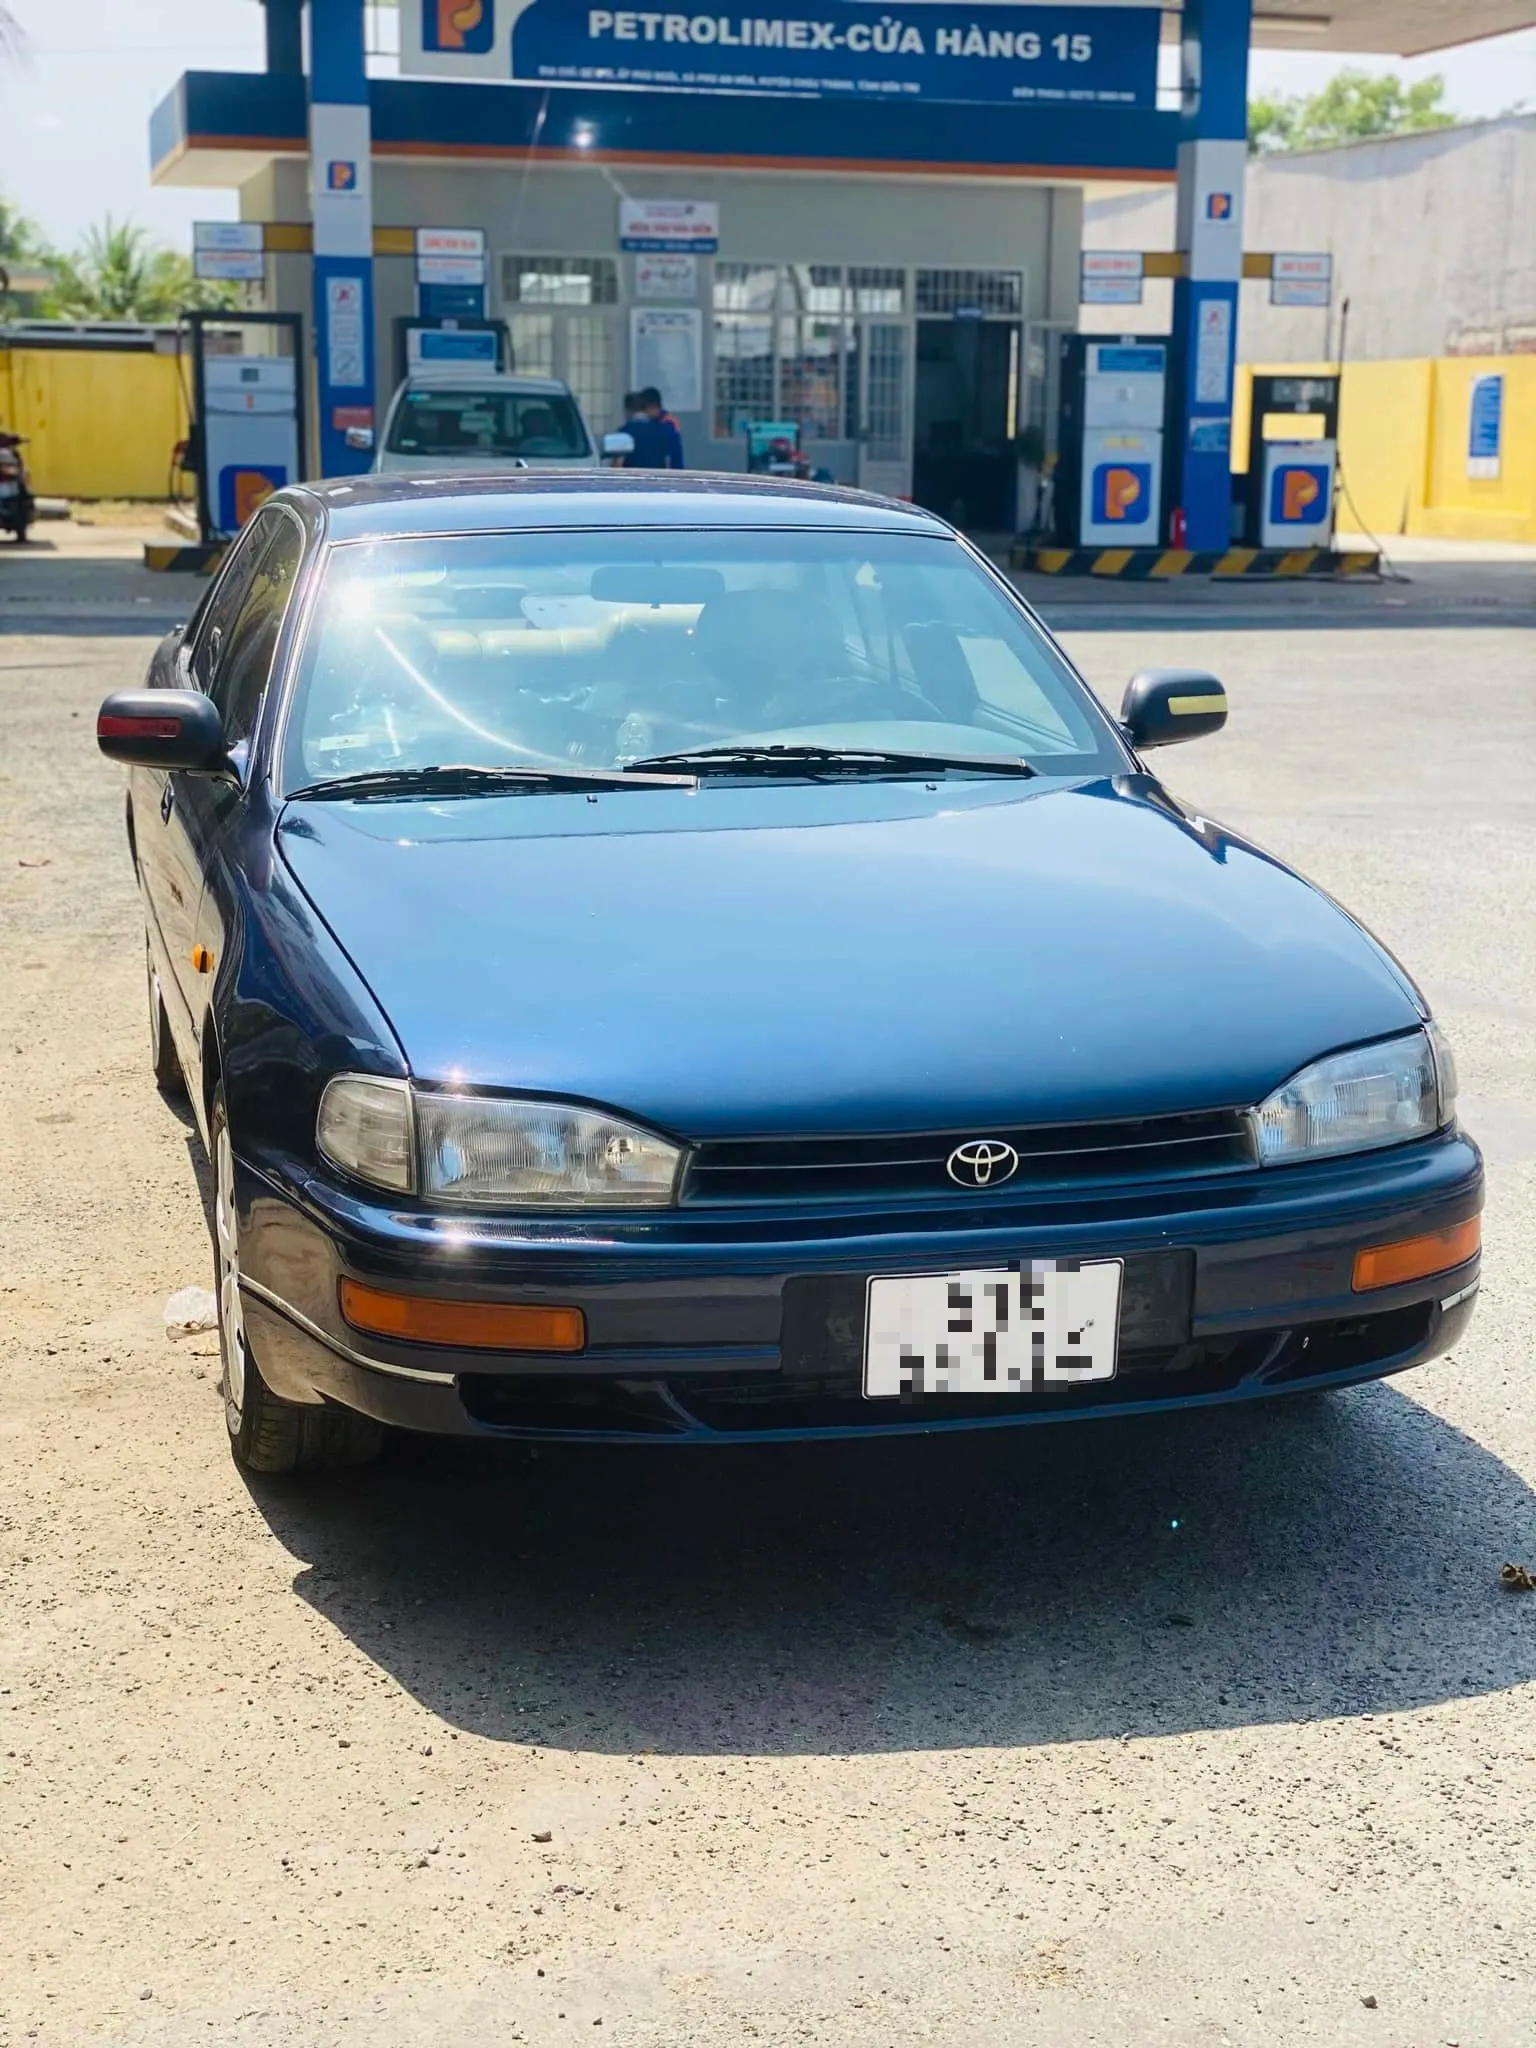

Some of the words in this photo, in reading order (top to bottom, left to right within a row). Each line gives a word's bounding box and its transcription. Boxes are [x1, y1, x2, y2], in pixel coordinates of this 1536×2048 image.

[588, 9, 925, 54] PETROLIMEX-CỬA
[936, 23, 1042, 59] HÀNG
[1052, 33, 1092, 62] 15
